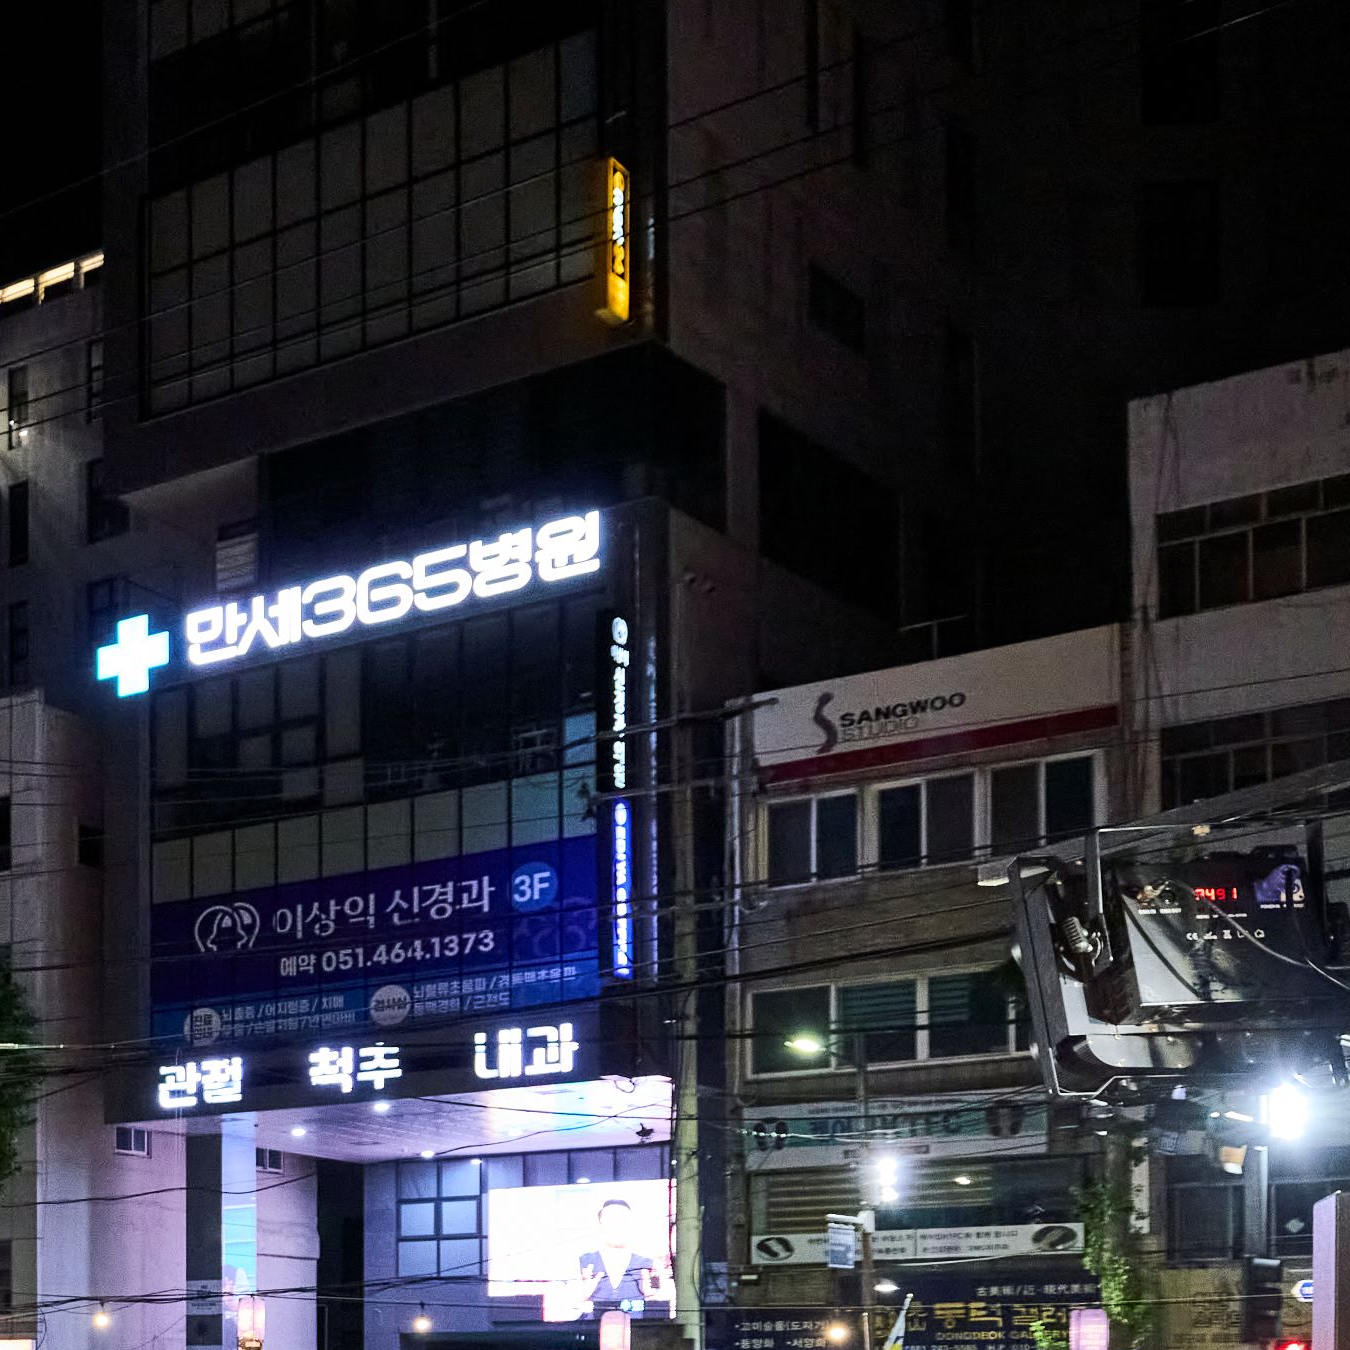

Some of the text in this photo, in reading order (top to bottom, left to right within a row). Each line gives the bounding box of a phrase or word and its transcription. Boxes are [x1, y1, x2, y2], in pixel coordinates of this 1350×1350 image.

[185, 510, 601, 666] 만세365병원
[839, 691, 966, 729] SANGWOO
[274, 869, 552, 939] 이상익 신경과 3F
[279, 929, 496, 978] 예약 051.464.1373
[308, 1041, 403, 1094] 척추
[473, 1022, 579, 1080] 내과
[157, 1055, 244, 1110] 관절
[1009, 1328, 1069, 1341] GALERY
[1011, 1303, 1069, 1328] 갤러
